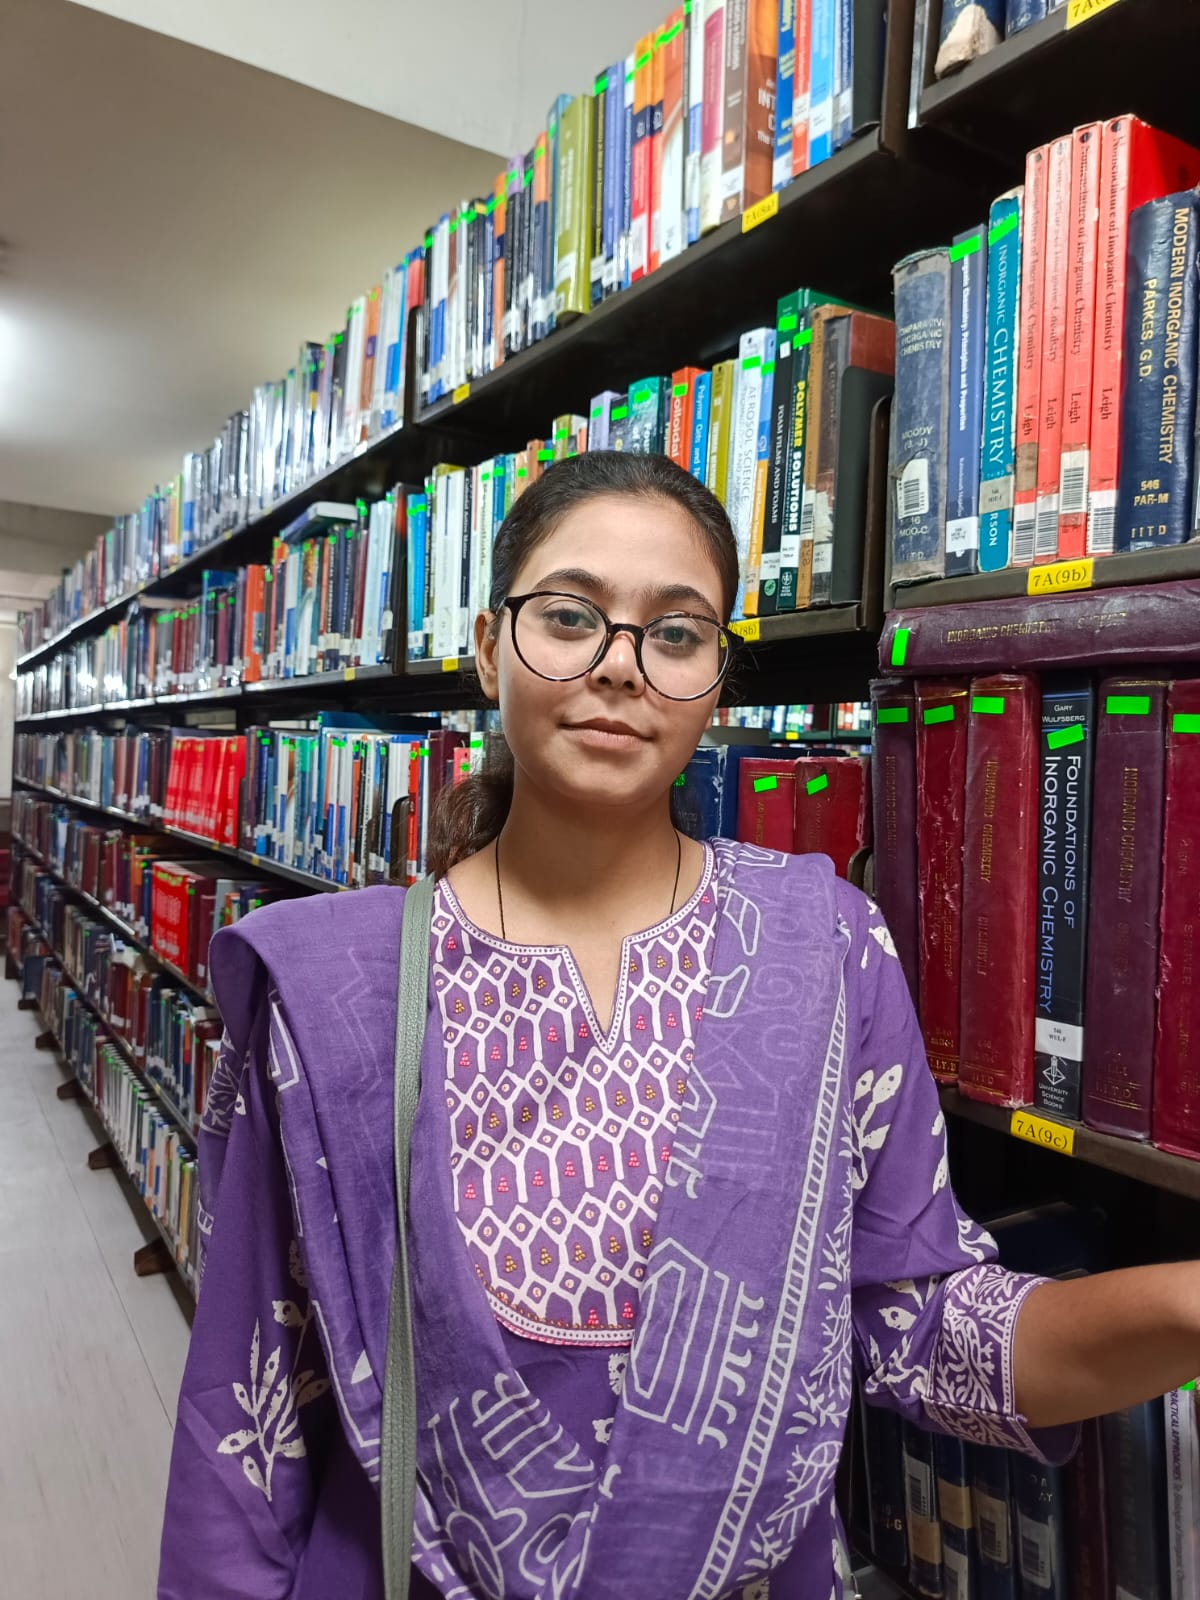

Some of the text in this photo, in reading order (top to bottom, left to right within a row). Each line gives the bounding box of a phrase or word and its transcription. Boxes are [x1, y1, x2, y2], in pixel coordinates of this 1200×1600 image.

[1104, 234, 1120, 291] Inorganic
[996, 244, 1008, 325] INORGANIC
[1069, 298, 1084, 357] Chemistry
[1102, 292, 1117, 352] Chemistry
[1158, 207, 1190, 465] MODERN INORGANIC CHEMISTRY
[1023, 314, 1038, 371] Chemistry
[695, 384, 706, 420] Polymer
[989, 326, 1010, 465] CHEMISTRY
[1045, 397, 1058, 430] Leigh
[1068, 391, 1082, 425] Leigh
[1100, 387, 1114, 421] Leigh
[671, 397, 683, 458] olloidal
[694, 423, 704, 444] Gels
[741, 385, 757, 503] AEROSOL SCIENCE
[693, 447, 702, 464] and
[770, 404, 785, 524] FOAM FILMS AND FOAMS
[788, 380, 806, 533] POLYMER SOLUTIONS
[1133, 493, 1169, 507] PAR-M
[1140, 479, 1160, 492] 546
[989, 512, 999, 547] RSON
[1032, 567, 1088, 587] 7A(9b)
[1041, 714, 1086, 724] WULFSBERG
[1053, 704, 1073, 712] GARY
[1063, 755, 1081, 929] FOUNDATIONS OF
[1039, 756, 1062, 1014] INORGANIC CHEMISTRY
[1041, 1090, 1065, 1103] SCIENCE
[1016, 1119, 1069, 1150] 7A(9c)
